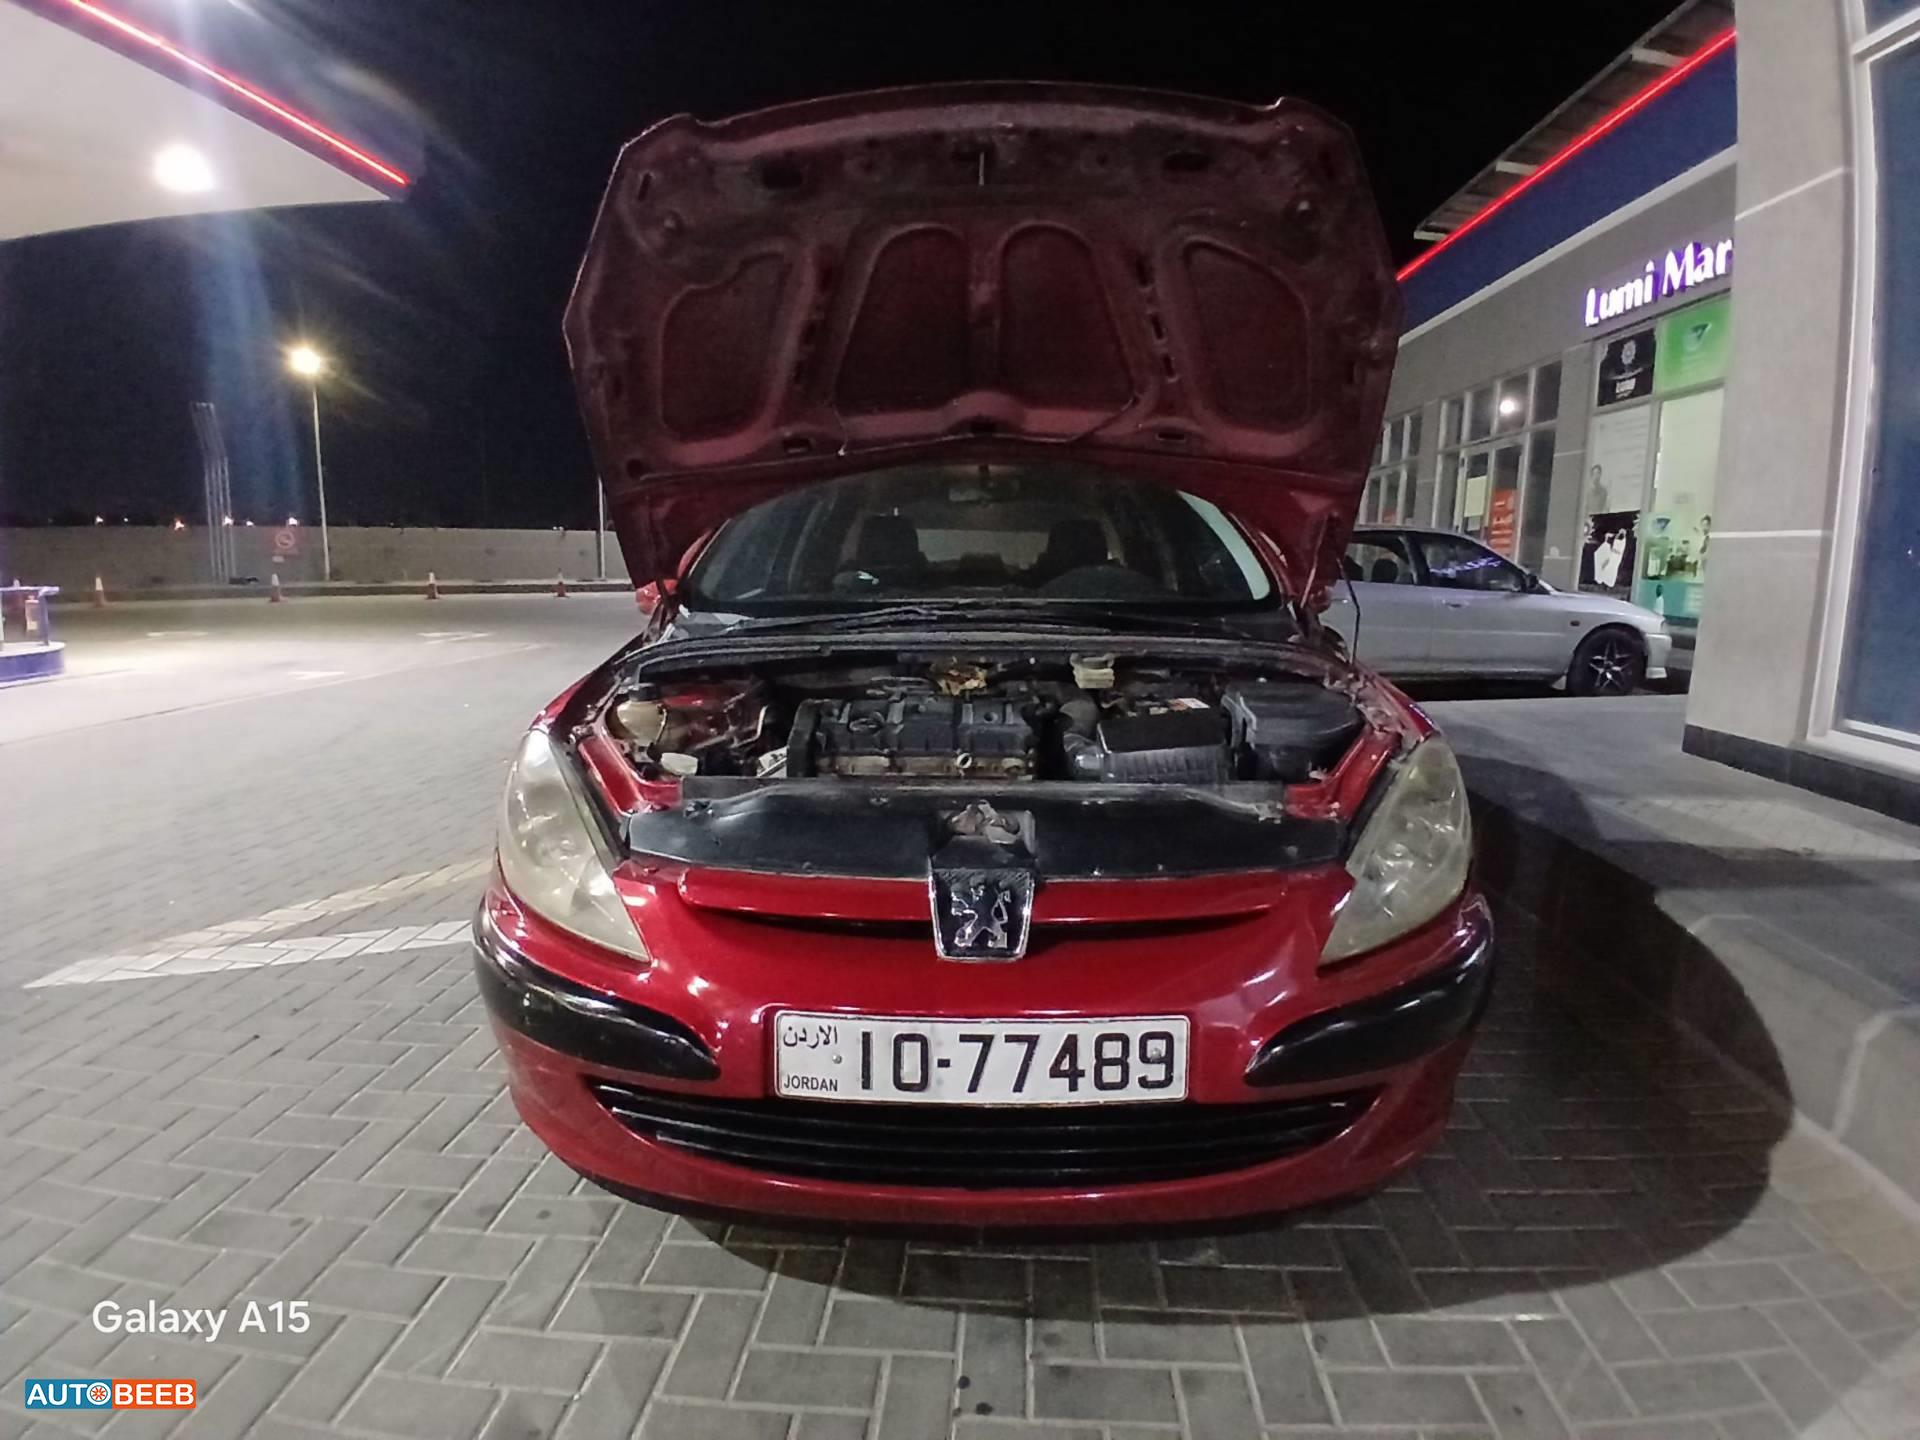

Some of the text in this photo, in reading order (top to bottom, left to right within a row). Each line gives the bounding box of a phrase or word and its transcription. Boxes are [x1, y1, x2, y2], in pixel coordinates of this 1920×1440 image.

[1584, 259, 1655, 326] Lumi
[783, 1075, 839, 1093] JORDAN
[860, 1030, 1175, 1094] 10-77489
